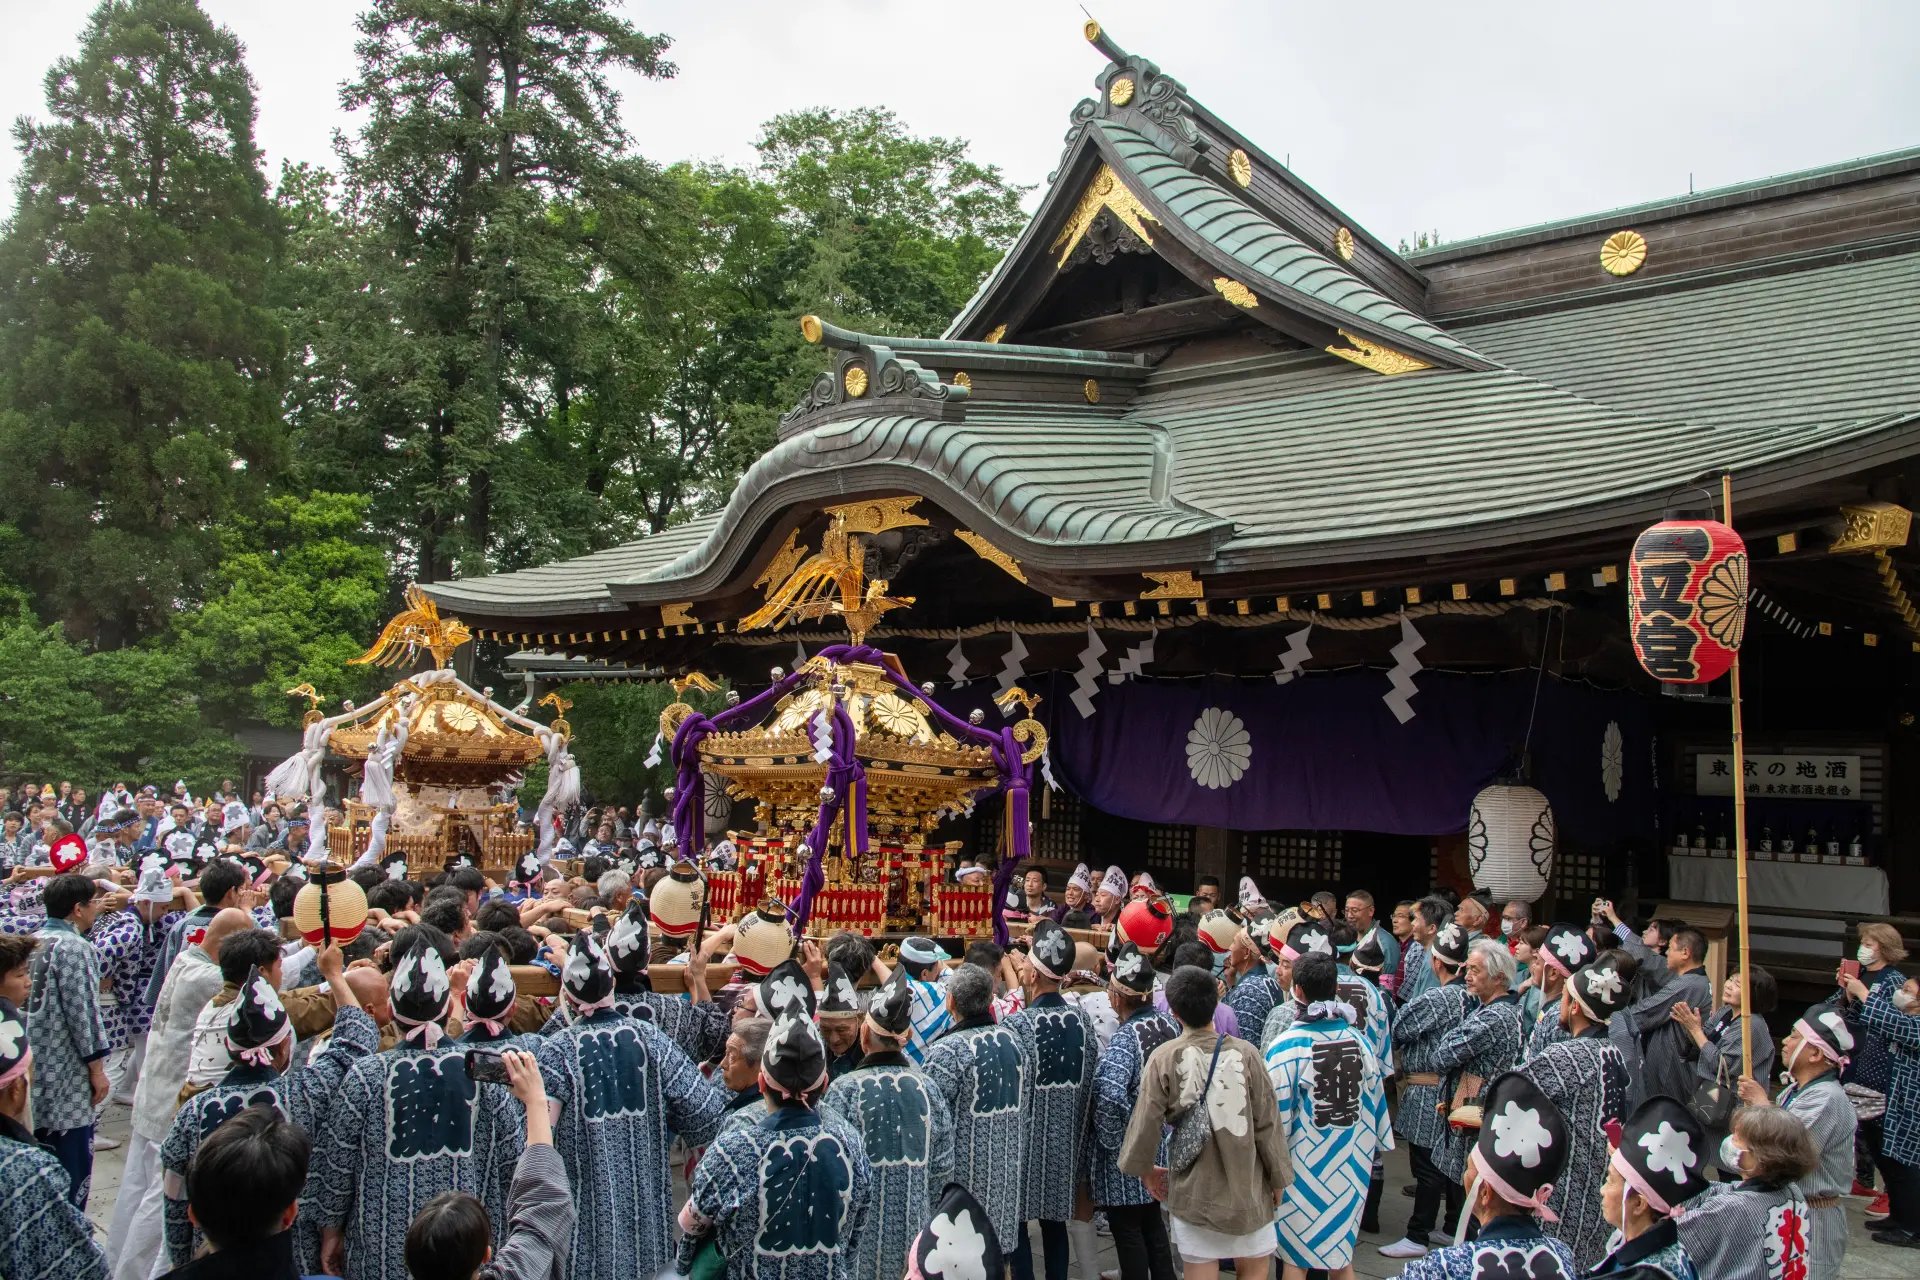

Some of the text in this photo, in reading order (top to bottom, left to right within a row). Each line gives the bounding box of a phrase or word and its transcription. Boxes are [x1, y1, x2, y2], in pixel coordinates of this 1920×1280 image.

[1709, 759, 1848, 779] 東京の地酒
[1765, 783, 1852, 796] 東京都酒造組合
